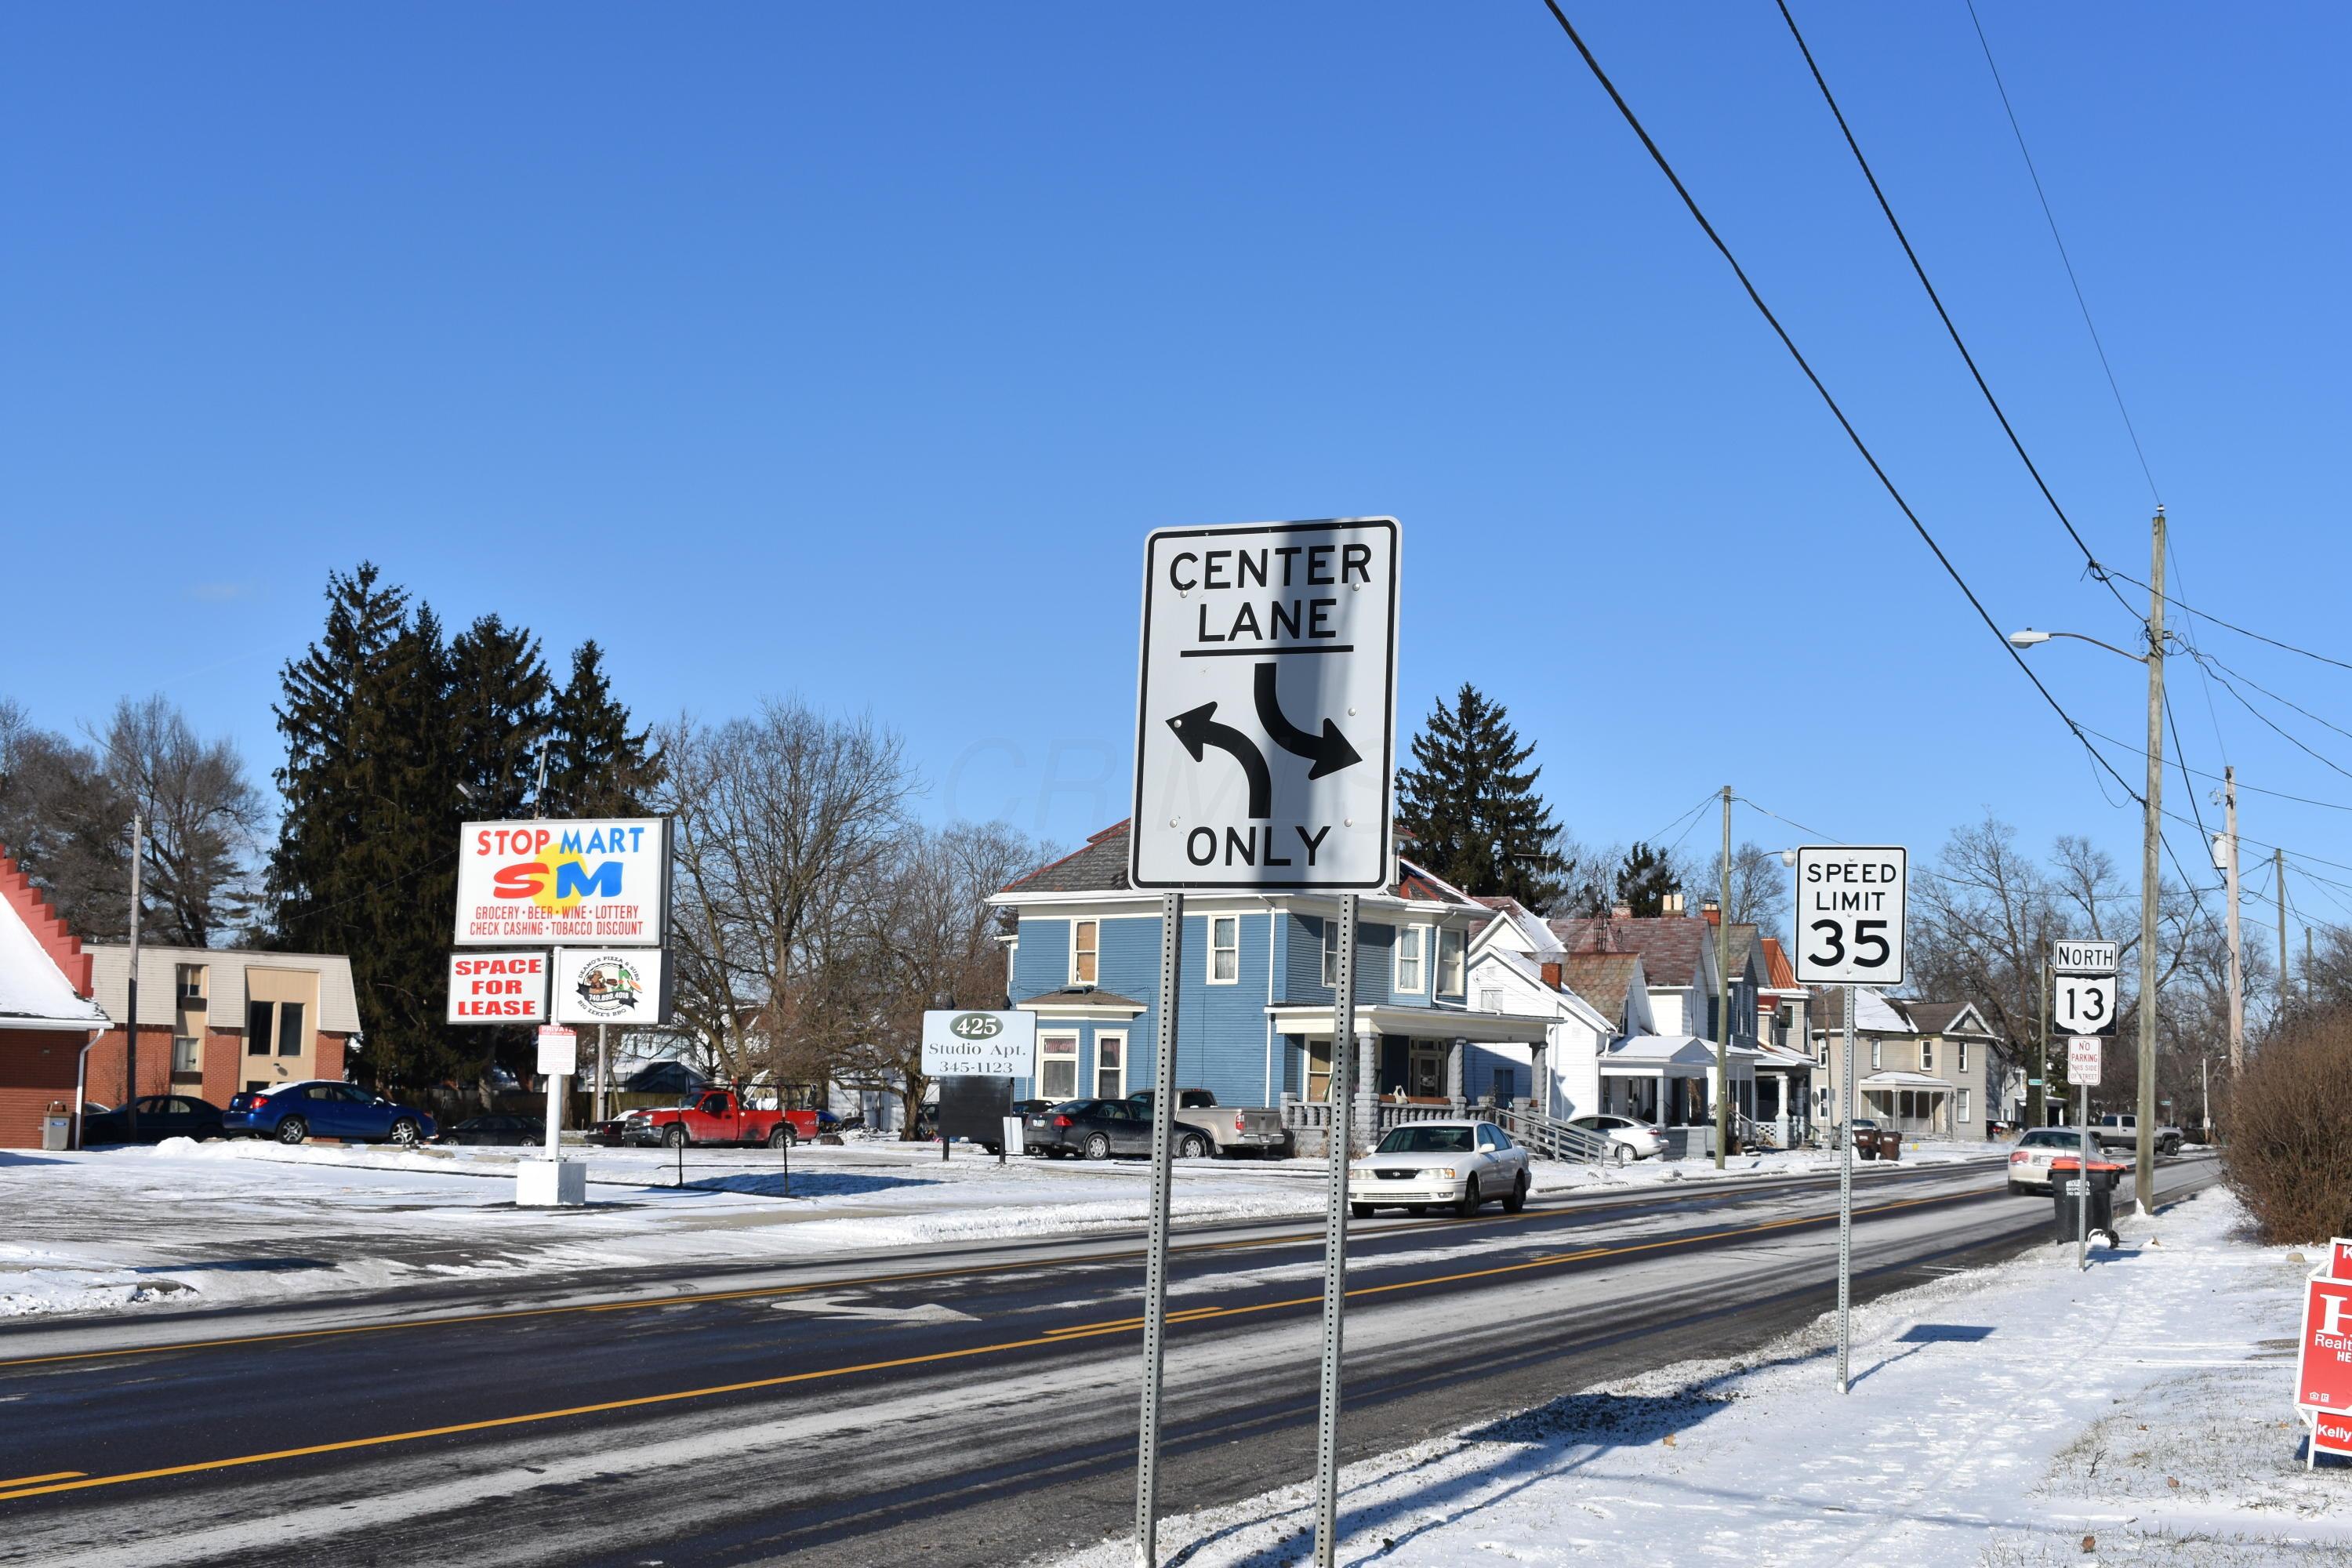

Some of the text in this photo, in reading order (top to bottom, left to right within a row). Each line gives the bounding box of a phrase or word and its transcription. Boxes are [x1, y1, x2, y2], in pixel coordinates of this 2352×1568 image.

[1170, 543, 1372, 592] CENTER
[1198, 598, 1338, 642] LANE
[477, 826, 645, 856] STOP MART
[1186, 826, 1331, 866] ONLY
[493, 861, 624, 899] SM
[1806, 863, 1896, 884] SPEED
[1816, 891, 1886, 911] LIMIT
[475, 905, 639, 920] GROCERY BEER WINE LOTTERY
[470, 920, 644, 936] CHECK CASHING TOBACCO DISCOUNT
[1807, 919, 1890, 968] 35
[2058, 946, 2113, 966] NORTH
[455, 959, 542, 975] SPACE
[630, 966, 641, 982] SUBS
[471, 980, 522, 995] FOR
[458, 1000, 535, 1016] LEASE
[578, 1000, 587, 1010] BIG
[2067, 987, 2104, 1021] 13
[956, 1018, 997, 1036] 425
[928, 1042, 1026, 1058] Studio Apt.
[2078, 1042, 2090, 1051] NO
[2071, 1053, 2098, 1062] PARKING
[939, 1061, 1013, 1073] 345-1123
[2317, 1424, 2352, 1443] Kelly
